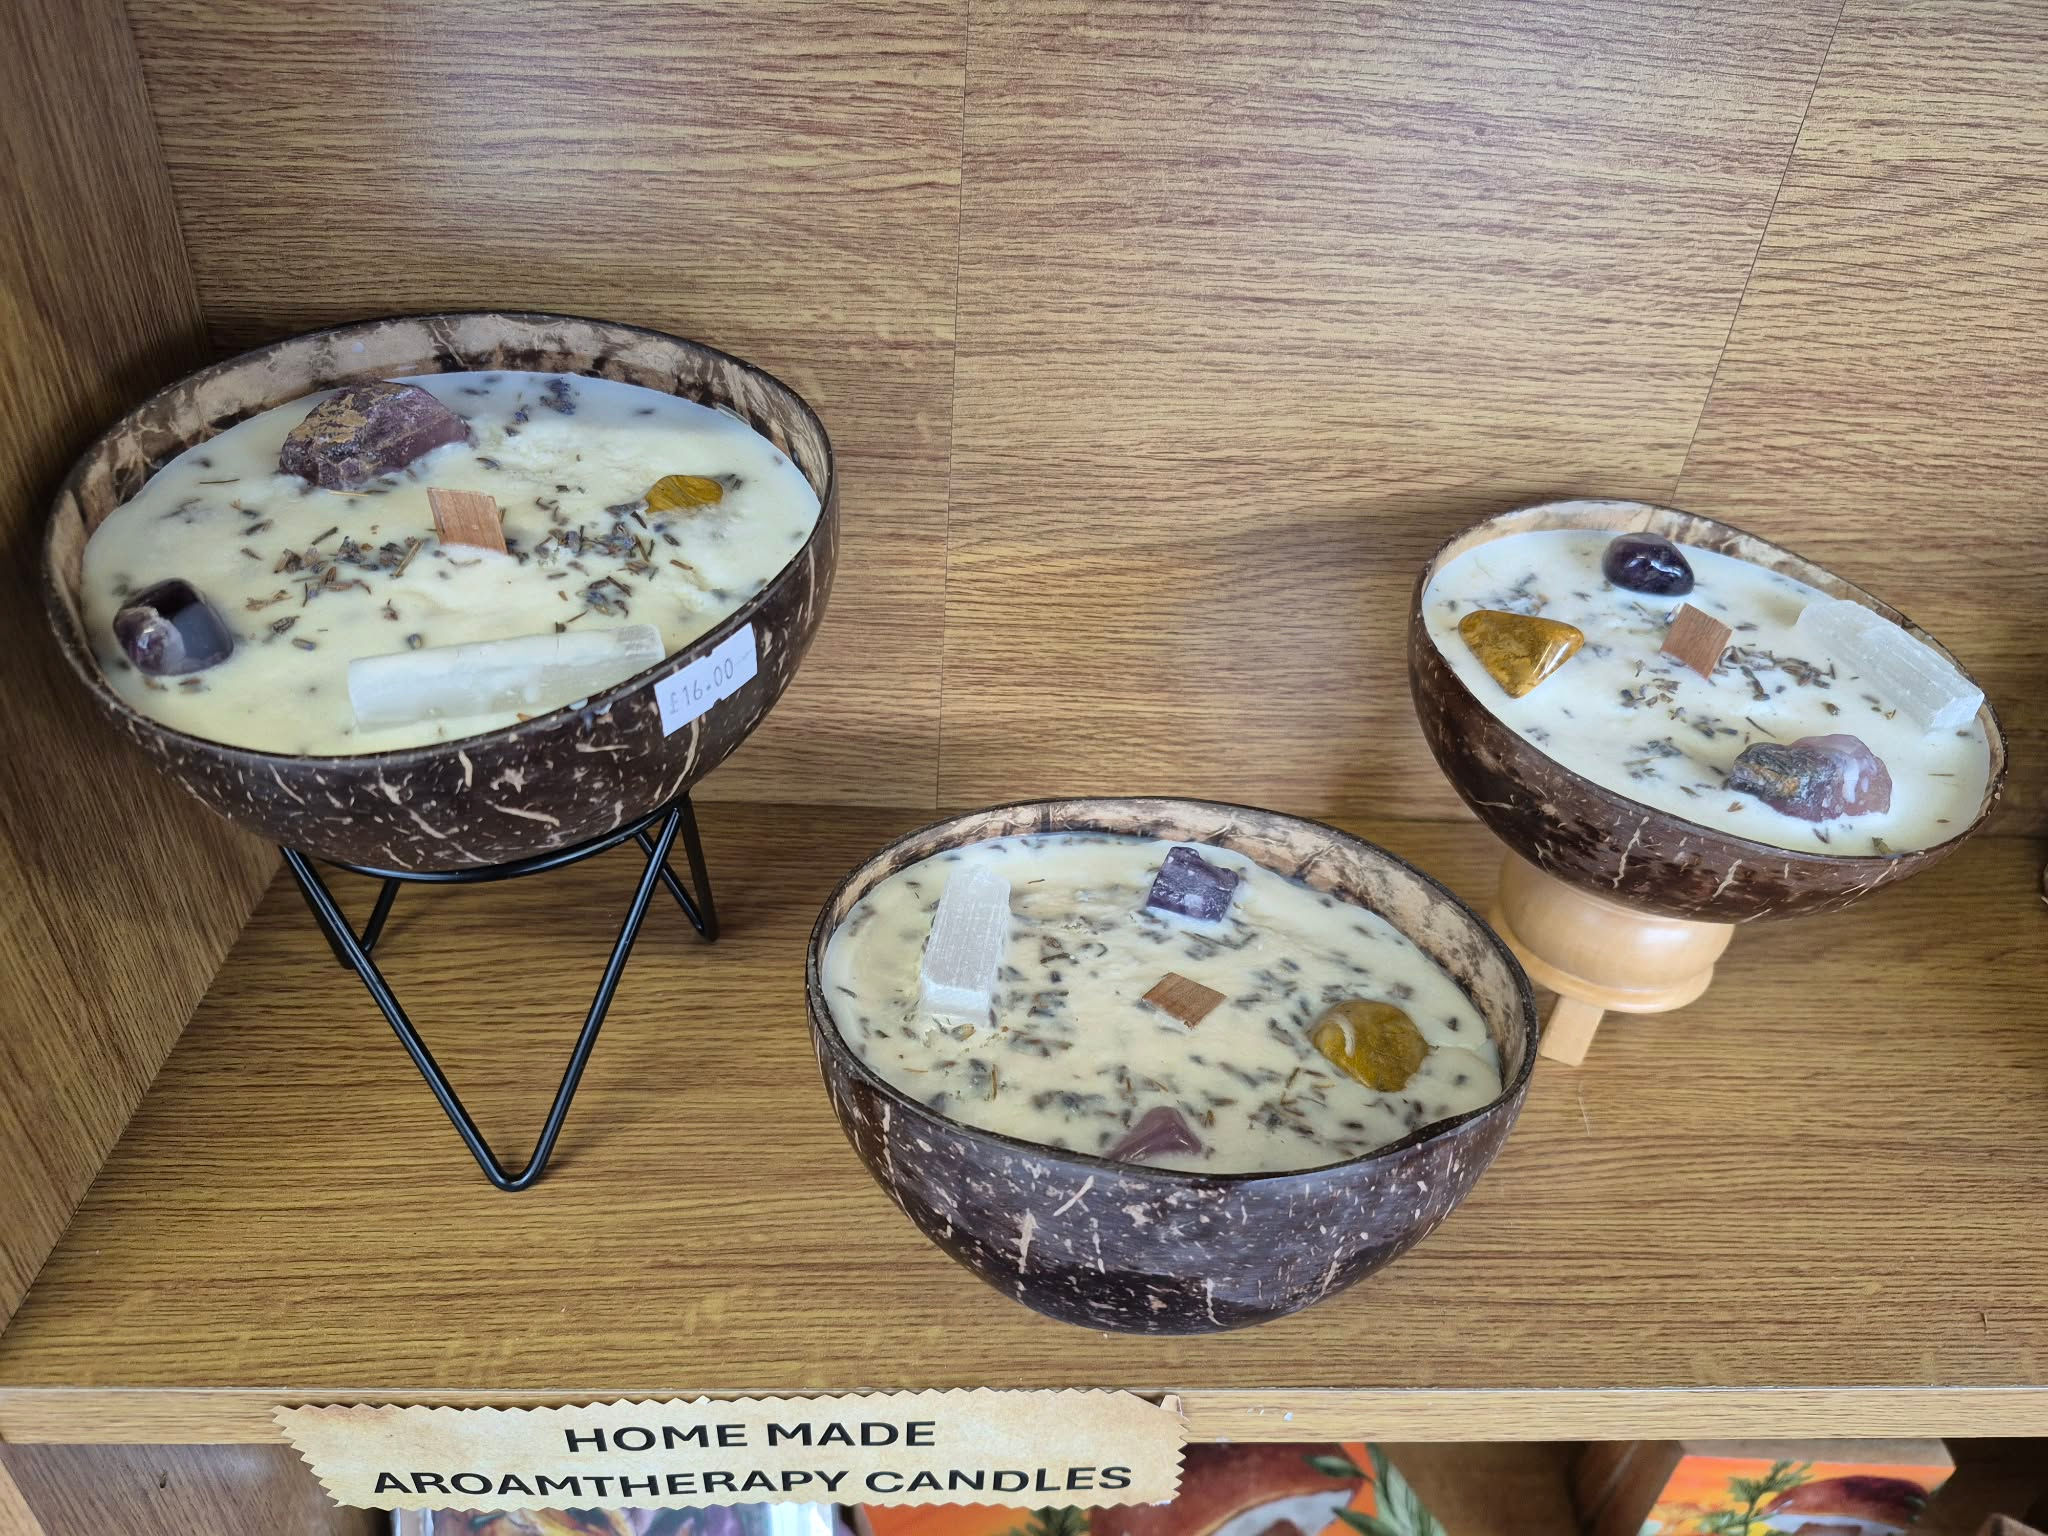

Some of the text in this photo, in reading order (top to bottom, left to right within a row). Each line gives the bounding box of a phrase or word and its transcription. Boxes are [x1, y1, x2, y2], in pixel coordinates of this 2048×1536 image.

[564, 1420, 937, 1453] HOME MADE
[373, 1466, 1132, 1498] AROAMTHERAPY CANDLES
